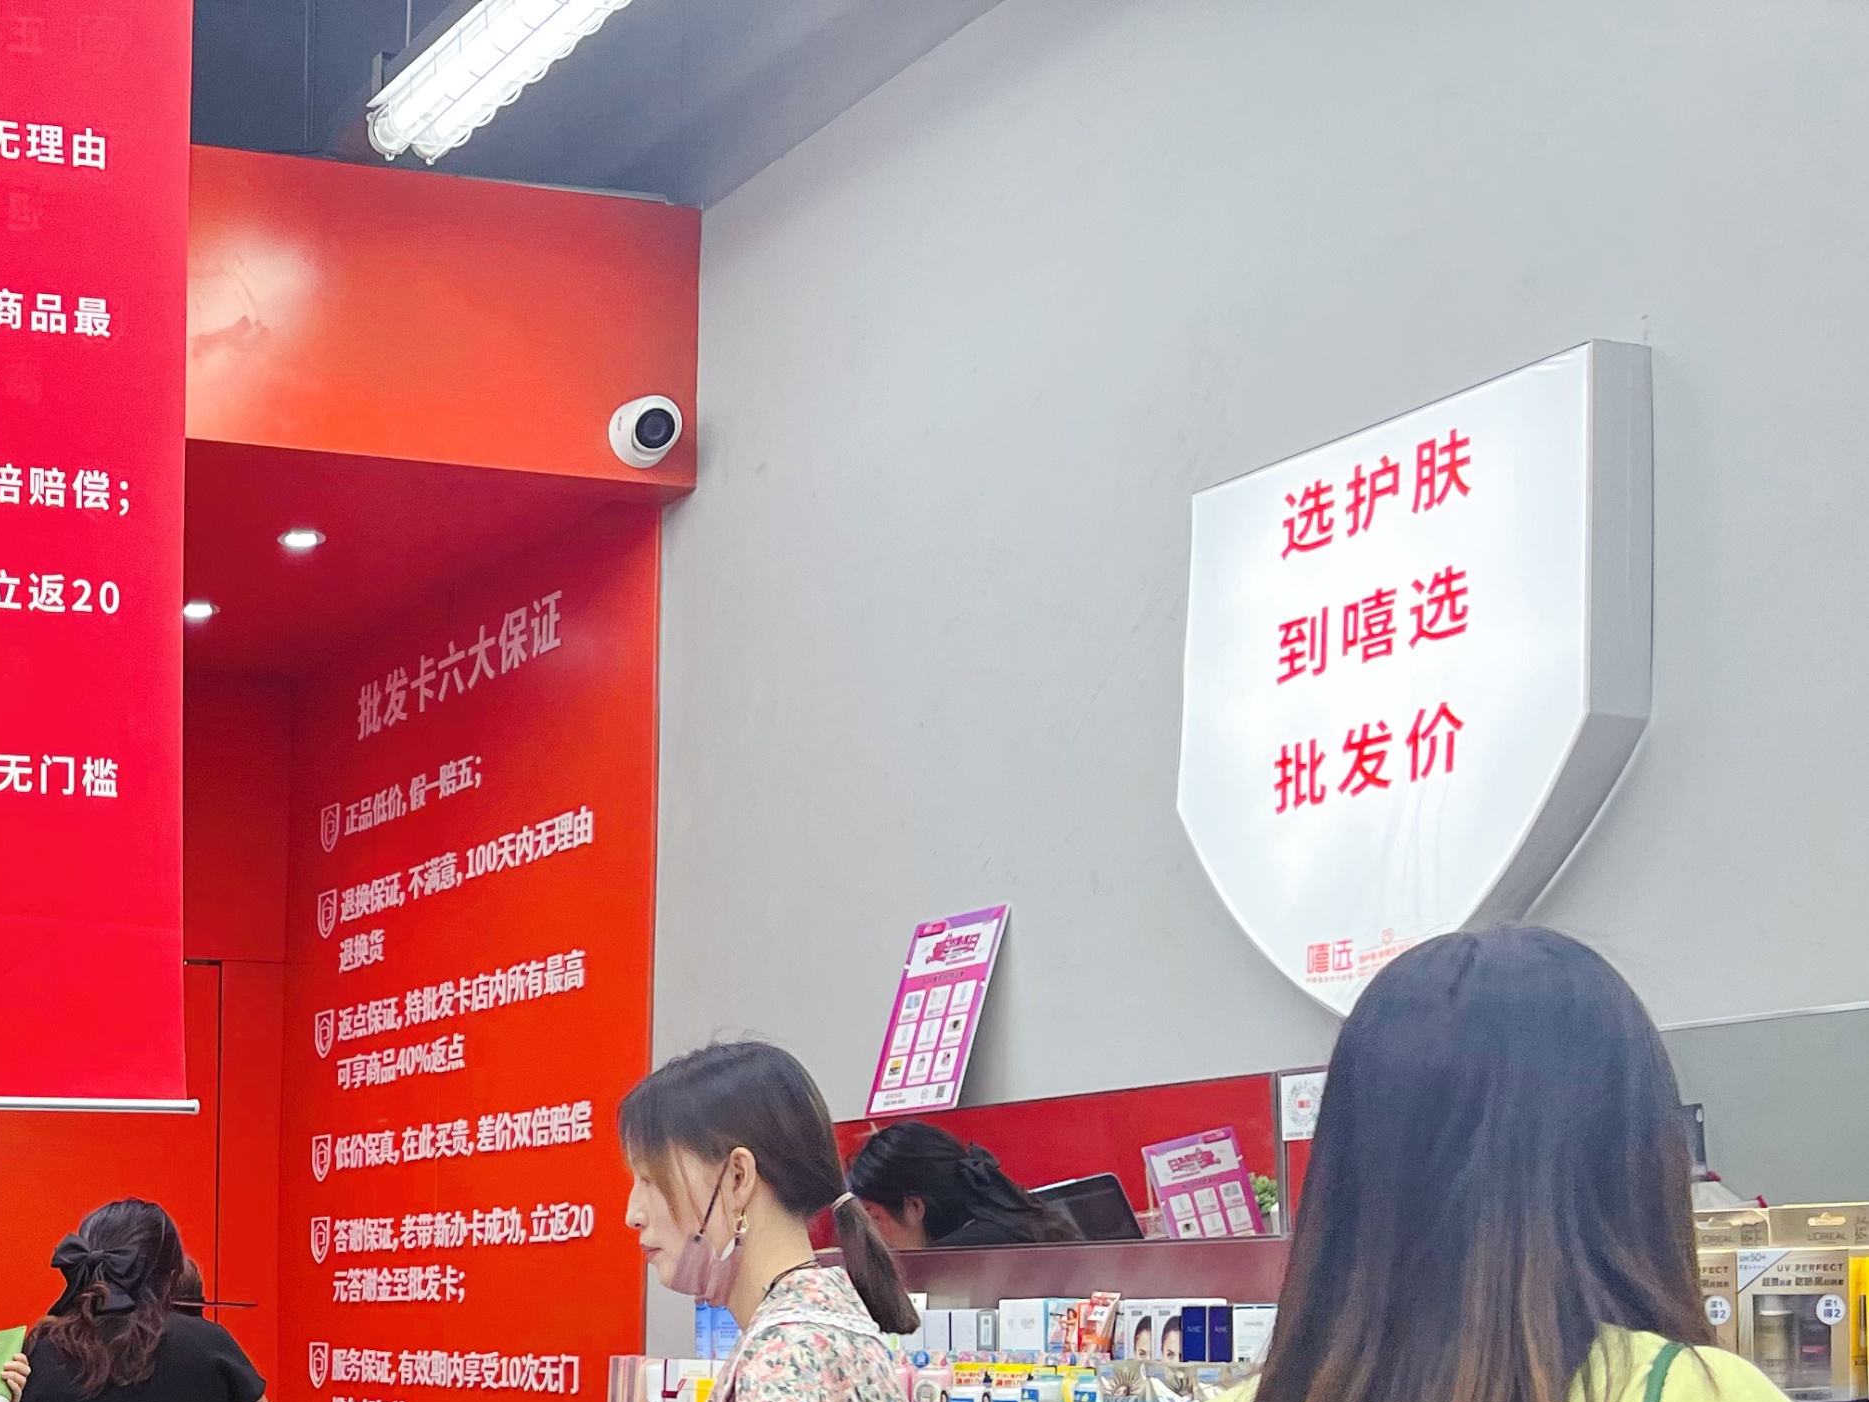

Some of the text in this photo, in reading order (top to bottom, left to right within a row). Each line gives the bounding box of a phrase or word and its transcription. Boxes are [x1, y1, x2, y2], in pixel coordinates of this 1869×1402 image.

[1281, 428, 1471, 559] 选护肤
[357, 590, 563, 742] 批发卡六大保证
[1276, 565, 1469, 685] 到嘻选
[1273, 701, 1464, 814] 批发价
[338, 929, 386, 974] 退换货
[336, 1034, 466, 1091] 可享商品40%返点
[1777, 1263, 1845, 1273] UV PERFECT
